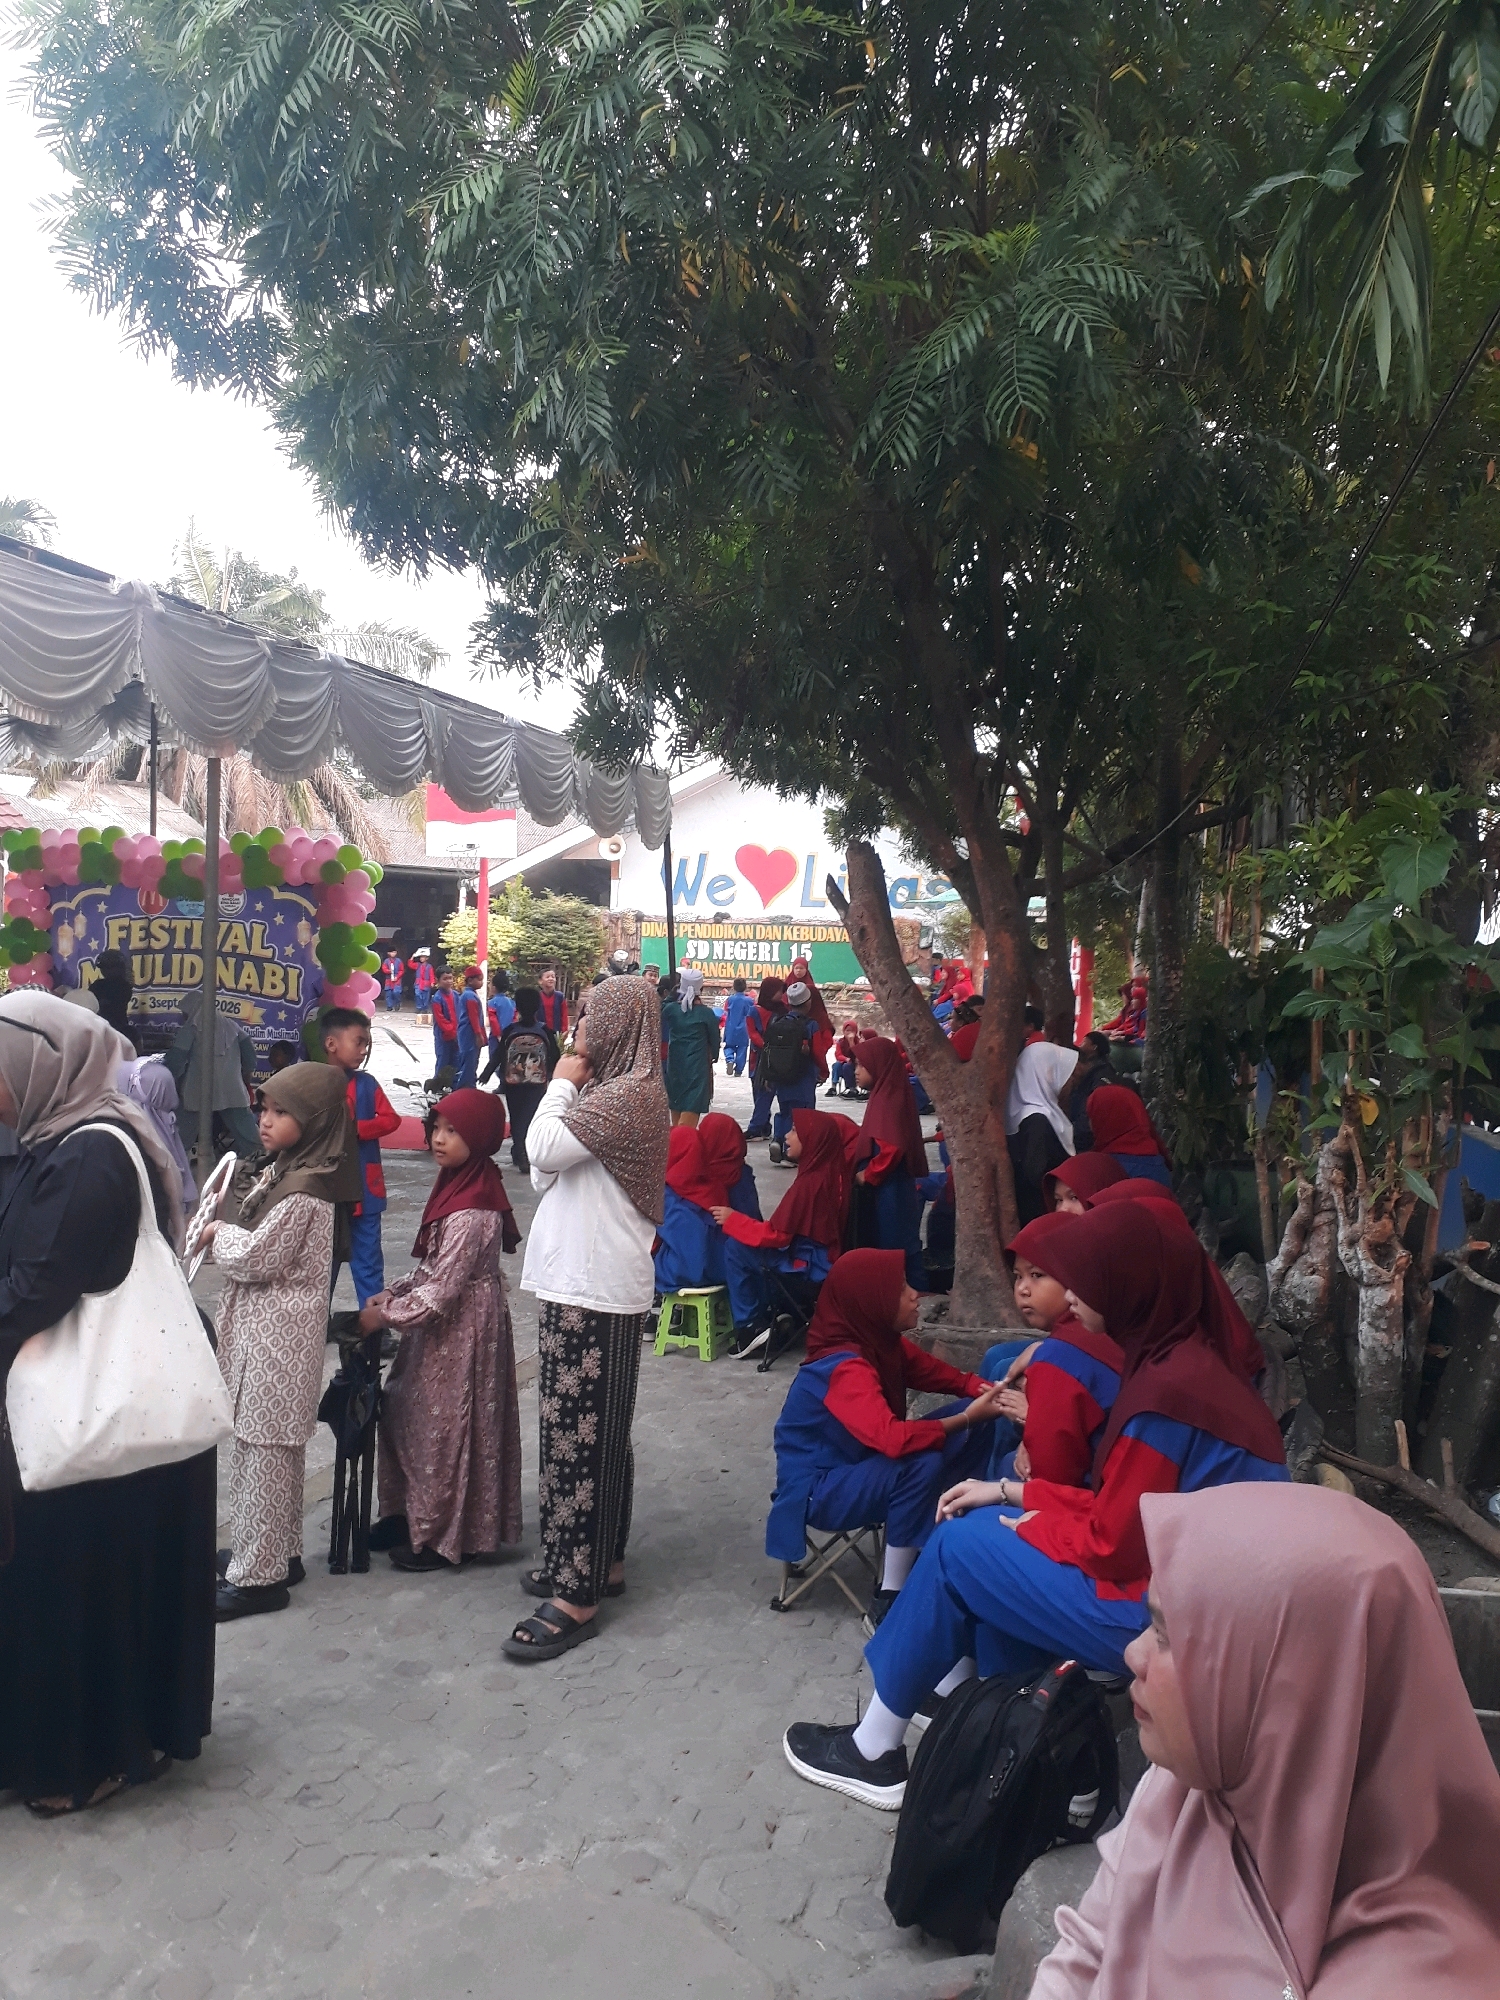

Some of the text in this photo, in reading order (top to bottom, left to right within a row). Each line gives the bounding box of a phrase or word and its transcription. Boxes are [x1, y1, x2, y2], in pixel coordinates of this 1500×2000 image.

[660, 851, 952, 909] We Lias
[107, 917, 273, 958] FESTIVAL
[680, 923, 753, 940] PENDIDIKAN
[755, 925, 781, 941] DAN
[783, 926, 850, 942] KEBUDAYA
[685, 940, 813, 963] SD NEGERI 15
[80, 954, 300, 1001] MULID NABI
[691, 962, 794, 980] PANGKALPINAN
[215, 1000, 241, 1014] 2026
[267, 1028, 299, 1040] Muslimah
